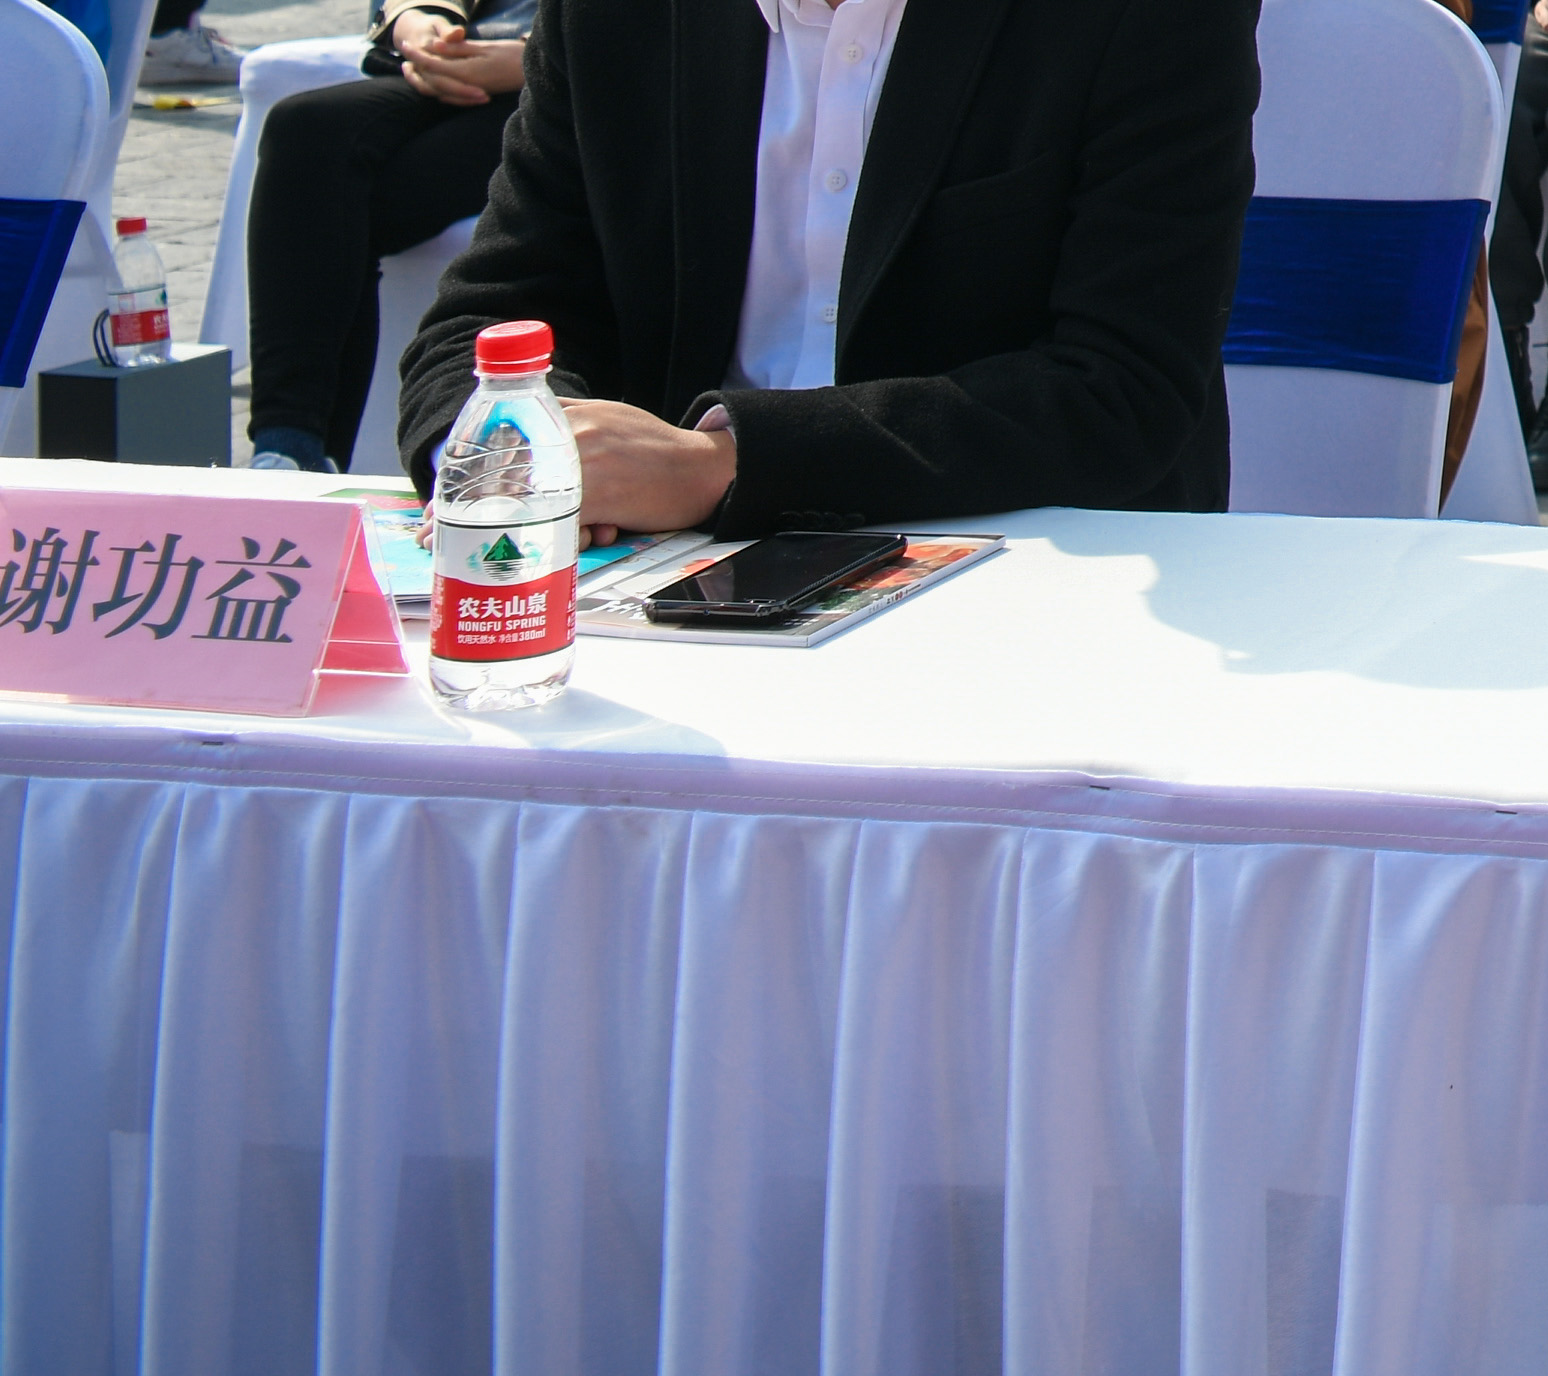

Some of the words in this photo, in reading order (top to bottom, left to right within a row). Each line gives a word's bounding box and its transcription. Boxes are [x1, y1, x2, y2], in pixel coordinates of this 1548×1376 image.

[0, 526, 312, 643] 谢功益
[458, 592, 547, 619] 农夫山泉
[458, 620, 502, 632] NONGFU
[505, 615, 546, 630] SPRING
